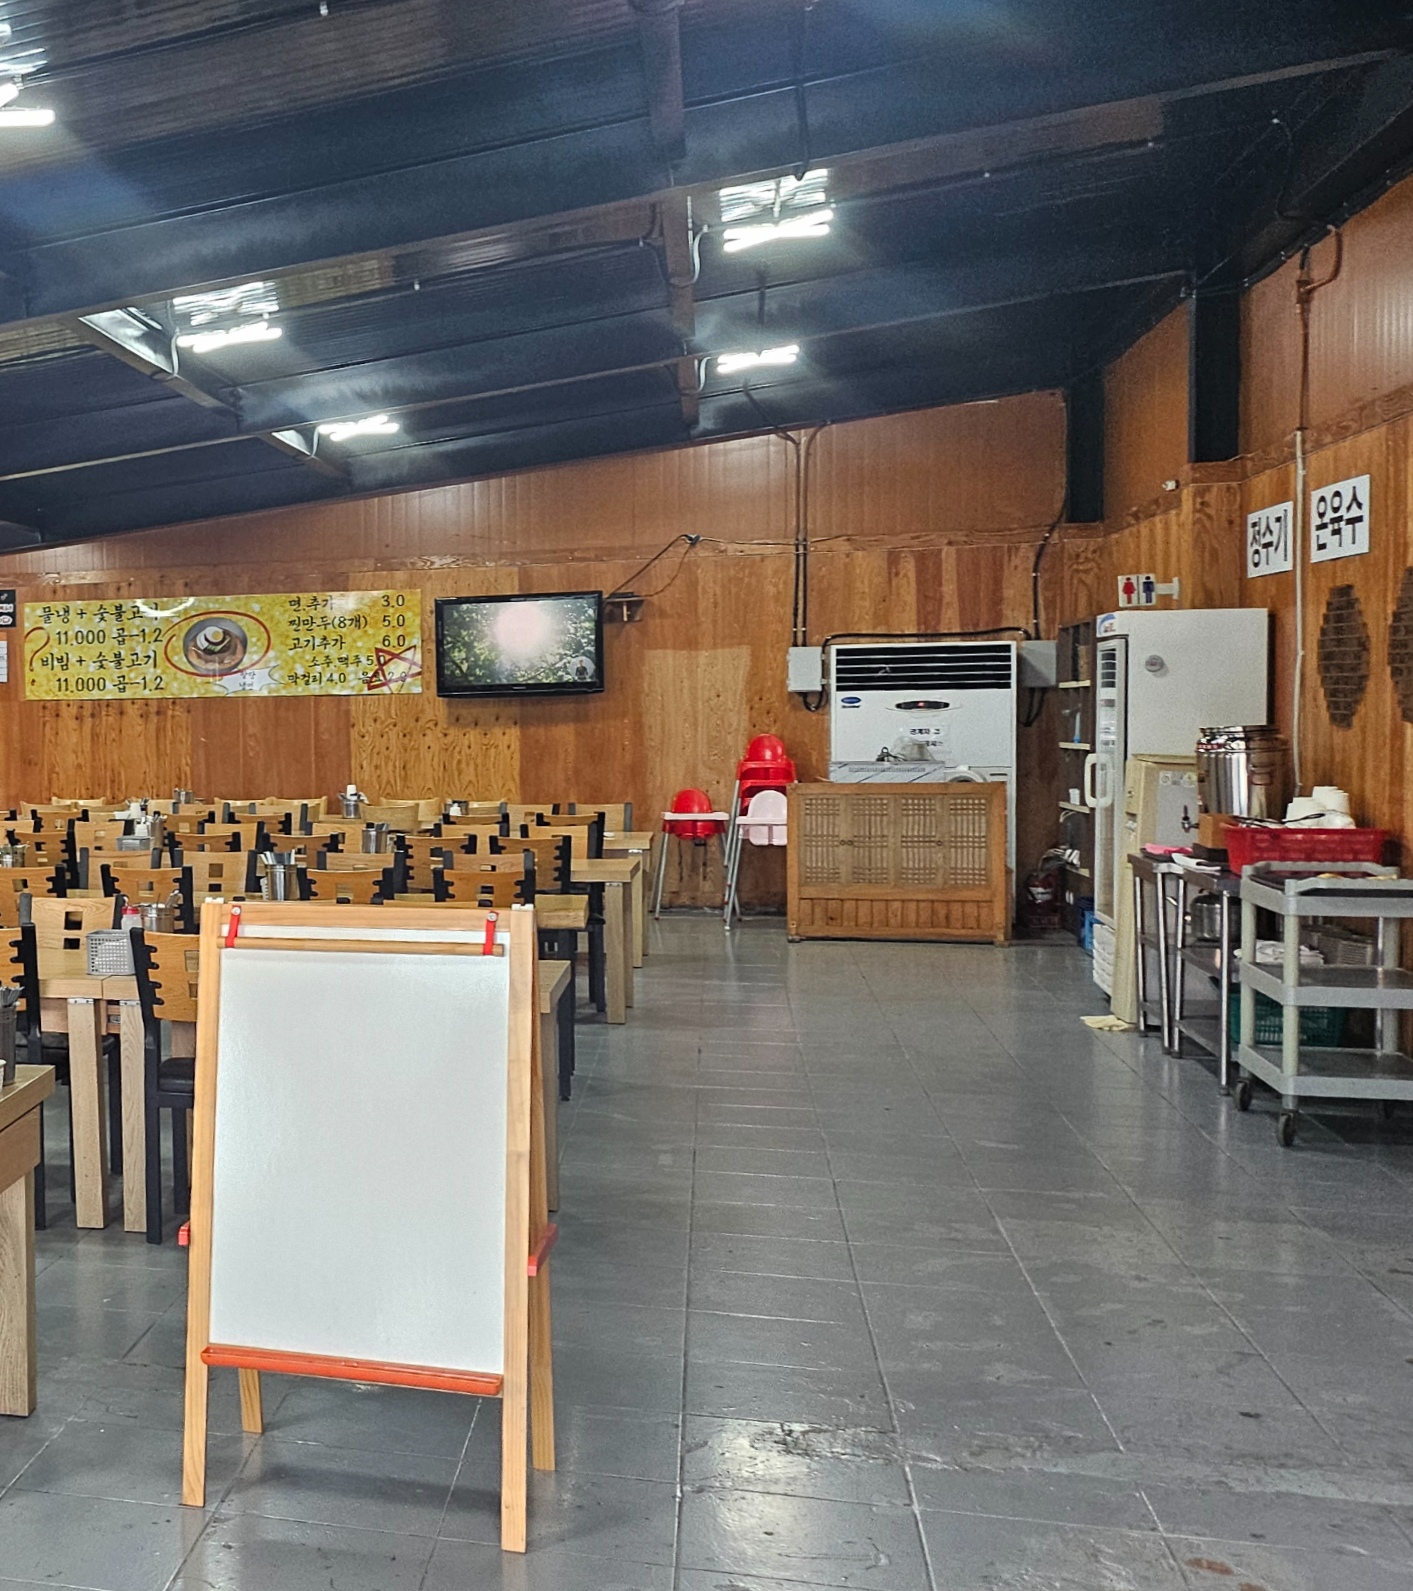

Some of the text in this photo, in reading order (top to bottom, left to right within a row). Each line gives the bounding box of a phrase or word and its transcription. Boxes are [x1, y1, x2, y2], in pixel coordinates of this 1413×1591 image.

[1315, 485, 1364, 551] 온육수
[1250, 508, 1288, 568] 정수기
[381, 594, 405, 608] 3.0
[38, 605, 71, 624] 물냉
[382, 614, 405, 628] 5.0
[56, 629, 106, 646] 11.000
[288, 634, 405, 651] 고기추가 6.0
[40, 652, 69, 671] 비빔
[56, 676, 106, 693] 11.000
[287, 672, 322, 685] 막걸리
